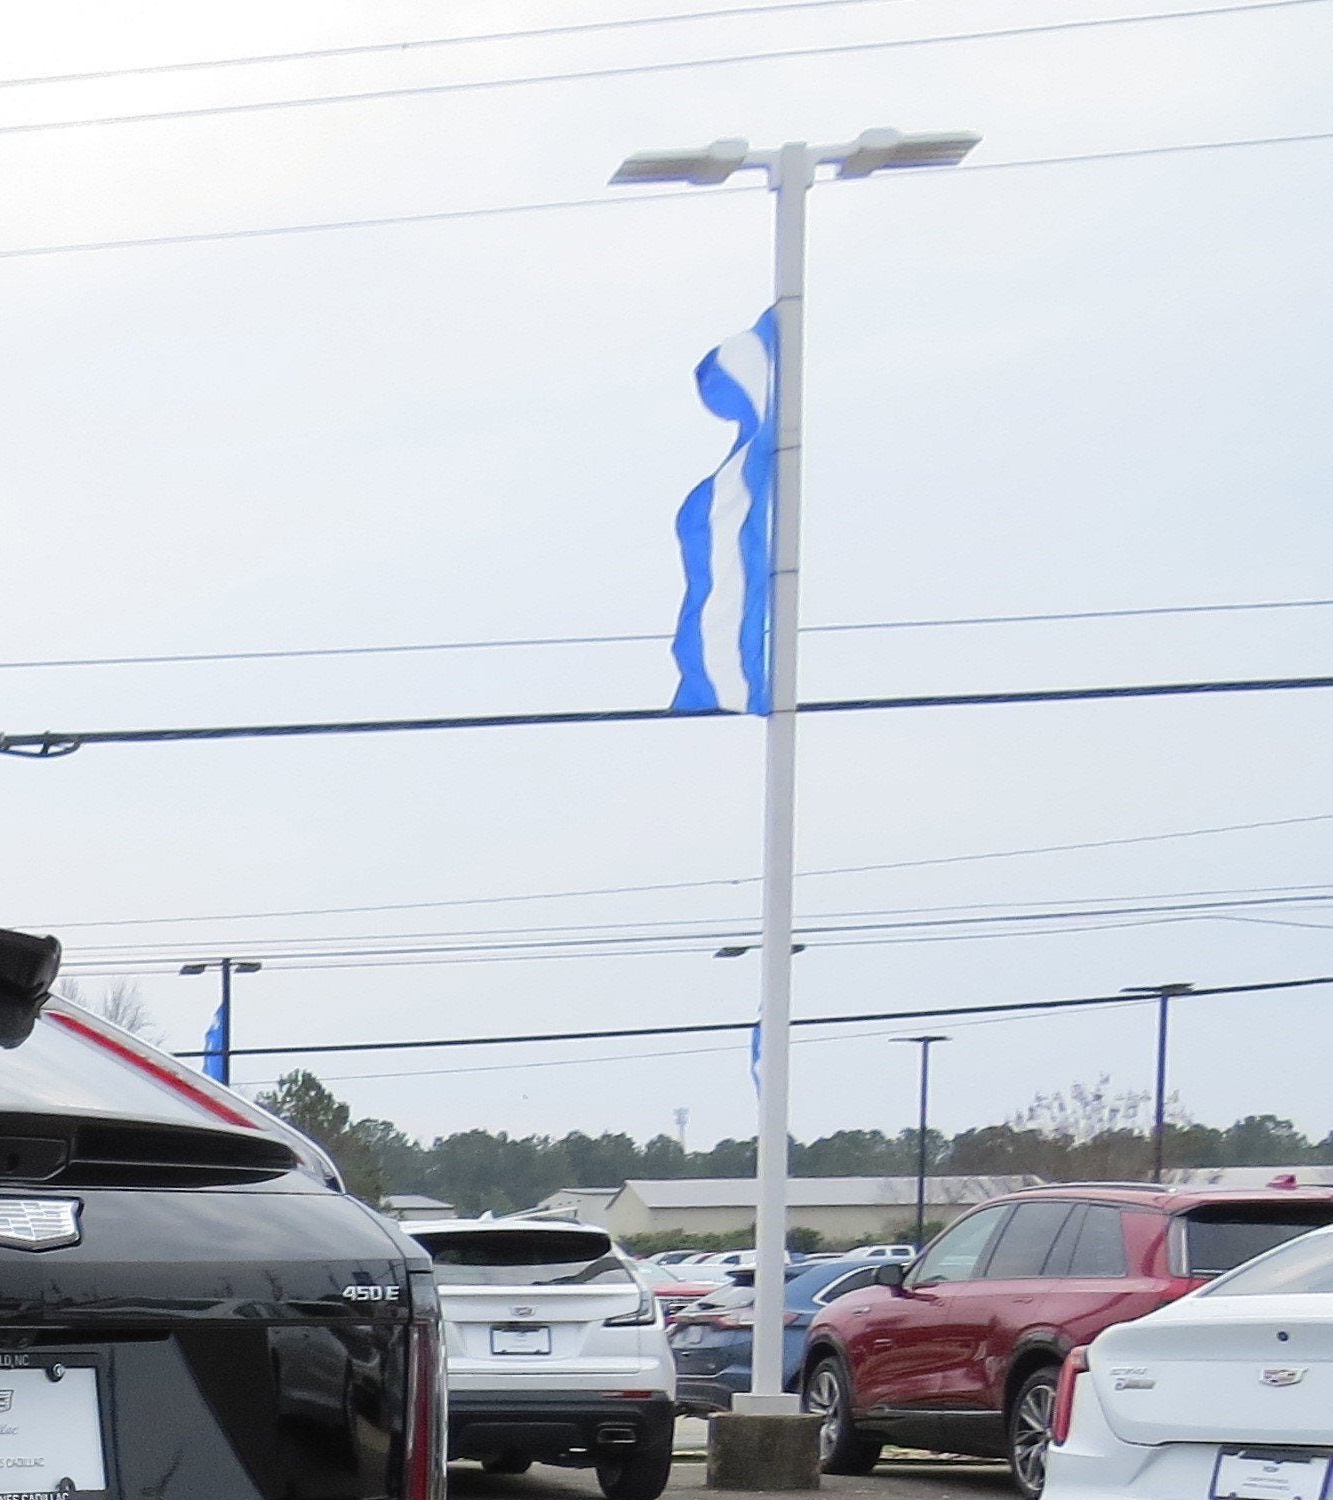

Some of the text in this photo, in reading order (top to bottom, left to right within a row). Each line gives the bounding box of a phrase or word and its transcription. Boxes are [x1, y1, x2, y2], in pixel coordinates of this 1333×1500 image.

[342, 1285, 400, 1301] 450 E
[15, 1354, 30, 1366] NC
[6, 1457, 45, 1469] CADILLAC
